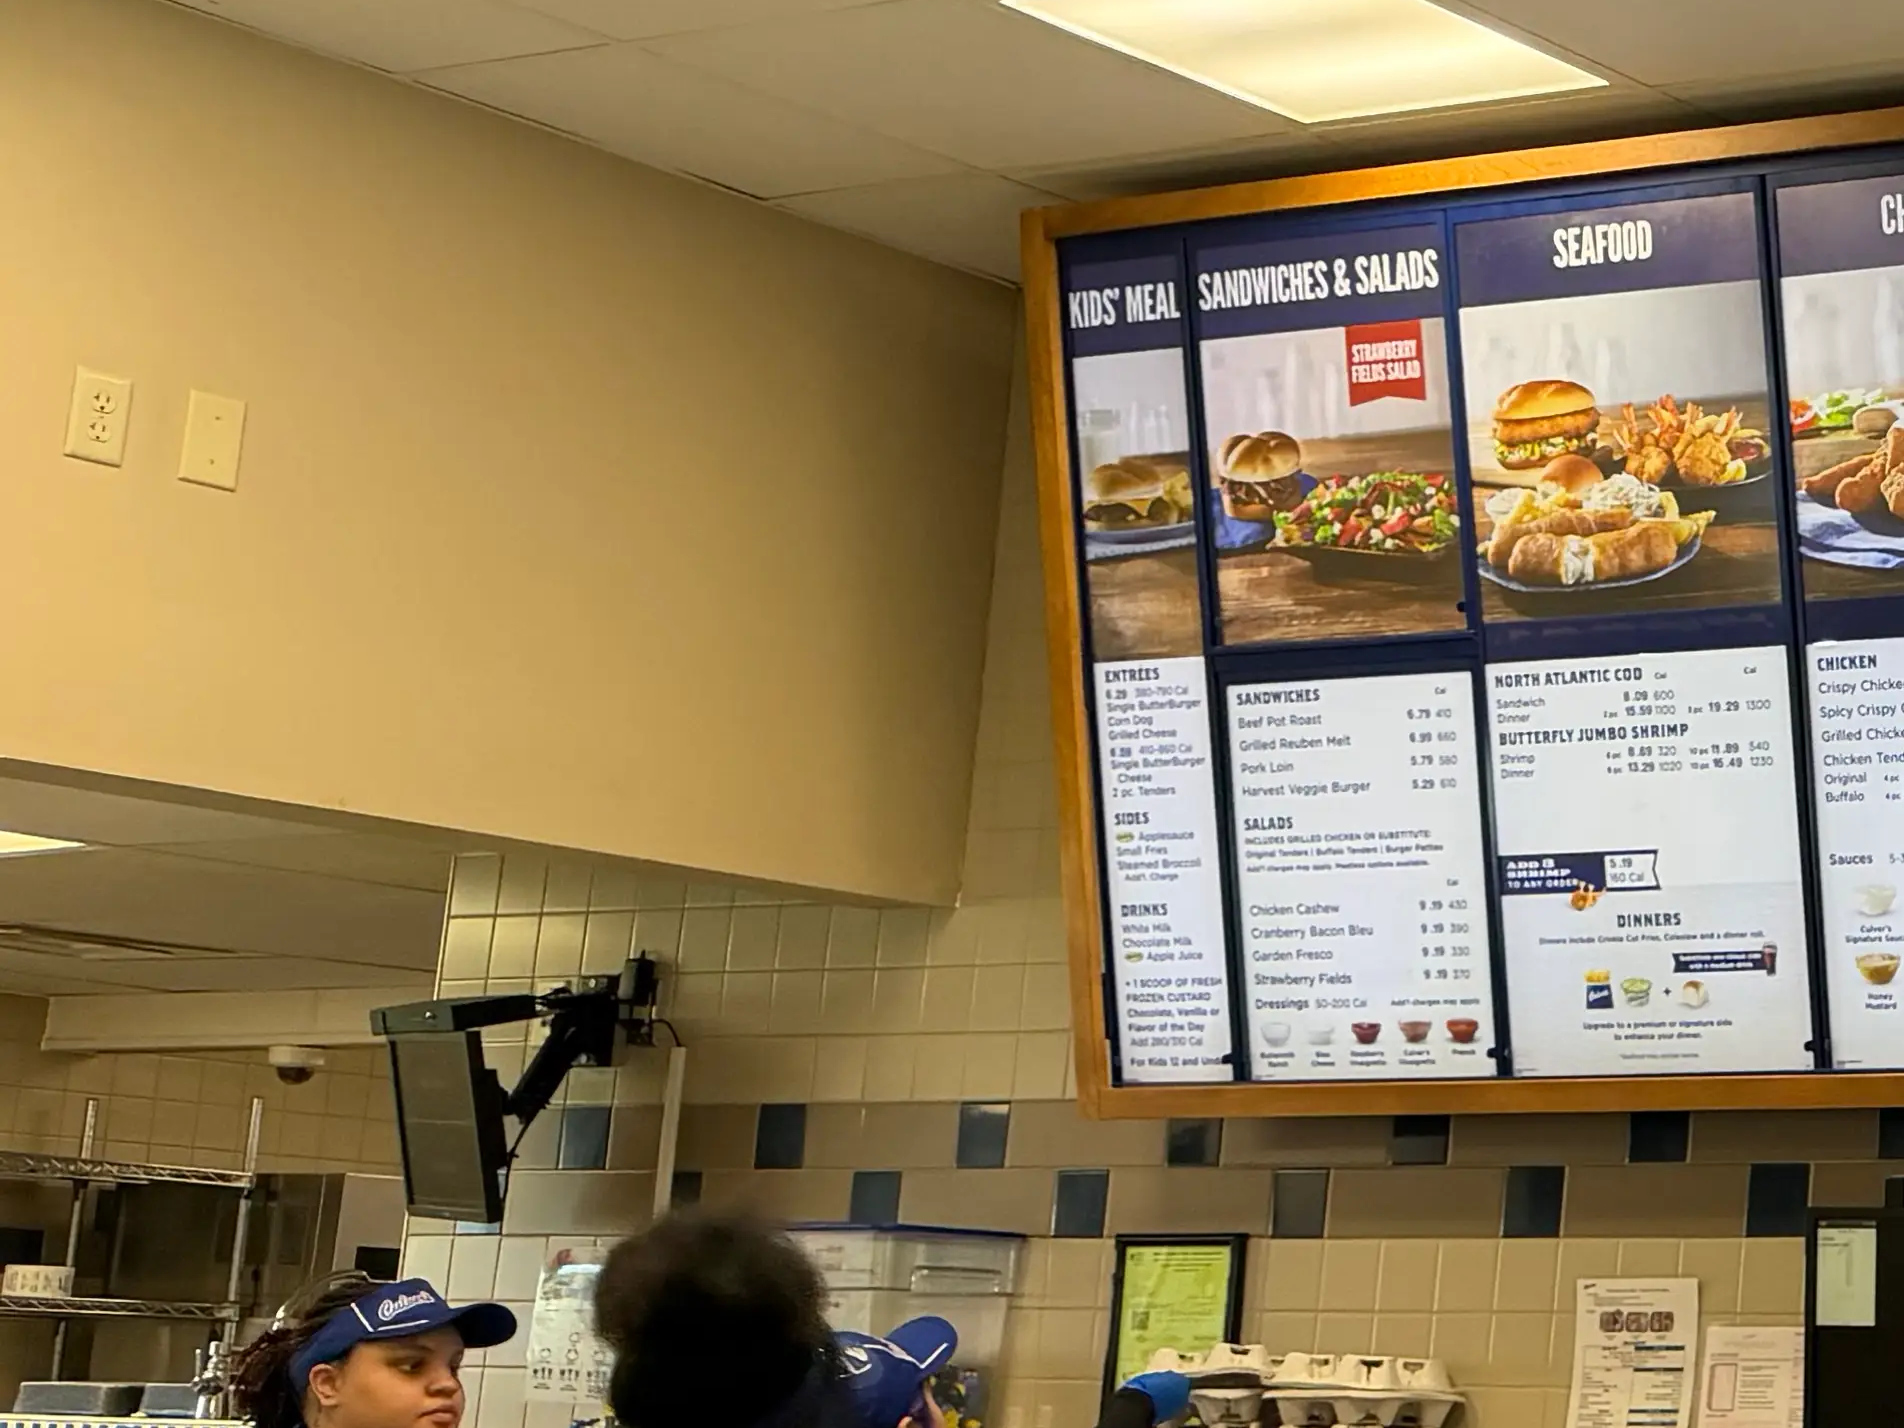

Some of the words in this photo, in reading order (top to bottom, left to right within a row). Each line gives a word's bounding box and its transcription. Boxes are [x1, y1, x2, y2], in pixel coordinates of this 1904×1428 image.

[1552, 221, 1653, 268] SEAFOOD
[1199, 260, 1329, 310] SANDWICHES
[1334, 259, 1351, 296] &
[1355, 249, 1439, 294] SALADS
[1070, 288, 1119, 328] KIDS'
[1125, 282, 1180, 322] MEAL
[1351, 340, 1418, 364] STRAWBERRY
[1351, 361, 1383, 383] FIELDS
[1386, 359, 1421, 380] SALAD
[1817, 655, 1876, 671] CHICKEN
[1495, 673, 1540, 688] NORTH
[1544, 669, 1610, 686] ATLANTIC
[1614, 667, 1643, 681] COD
[1237, 689, 1320, 705] SANDWICHES
[1818, 682, 1856, 695] Crispy
[1244, 817, 1293, 831] SALADS
[1617, 913, 1681, 928] DINNERS
